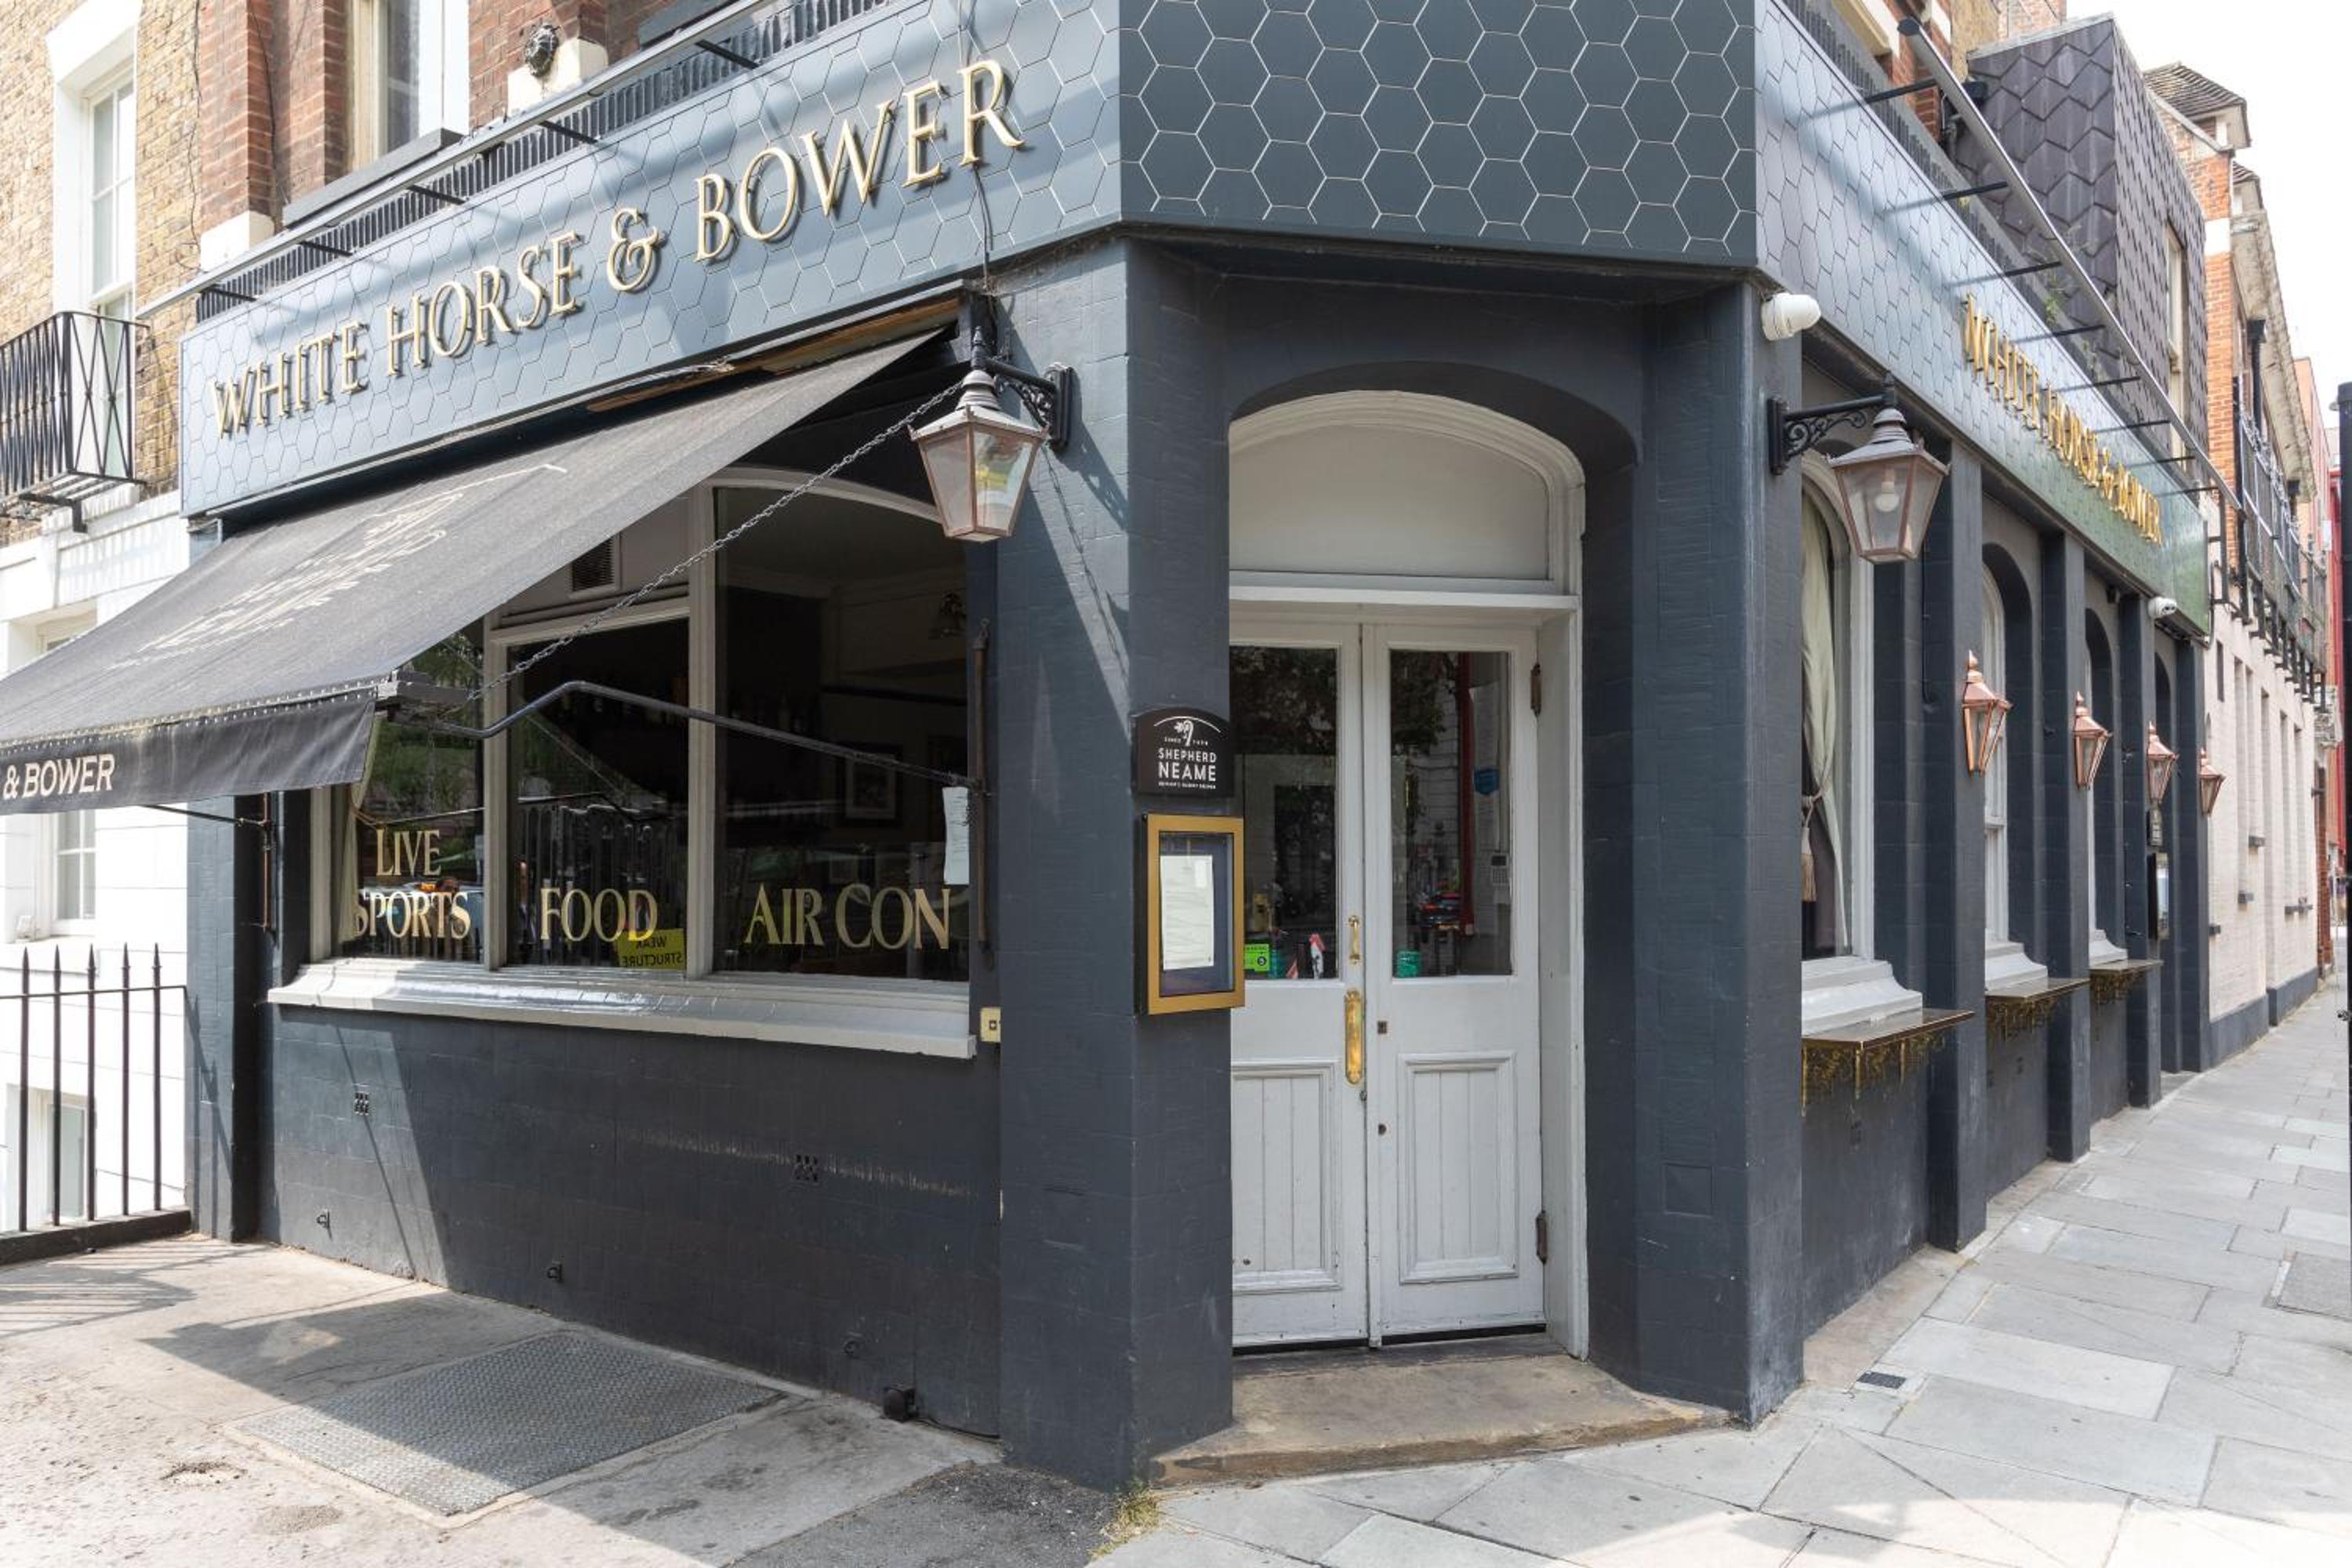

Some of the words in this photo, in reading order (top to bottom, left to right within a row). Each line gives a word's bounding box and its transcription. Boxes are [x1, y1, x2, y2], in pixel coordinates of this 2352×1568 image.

[210, 320, 370, 440] WHITE
[386, 230, 583, 378] HORSE
[606, 206, 665, 292] &
[693, 58, 1025, 263] BOWER
[2, 764, 20, 800] &
[22, 753, 115, 798] BOWER
[1158, 747, 1218, 763] SHEPHERD
[1158, 761, 1217, 782] NEAME
[376, 829, 441, 877] LIVE
[354, 890, 470, 940] SPORTS
[540, 887, 659, 941] FOOD
